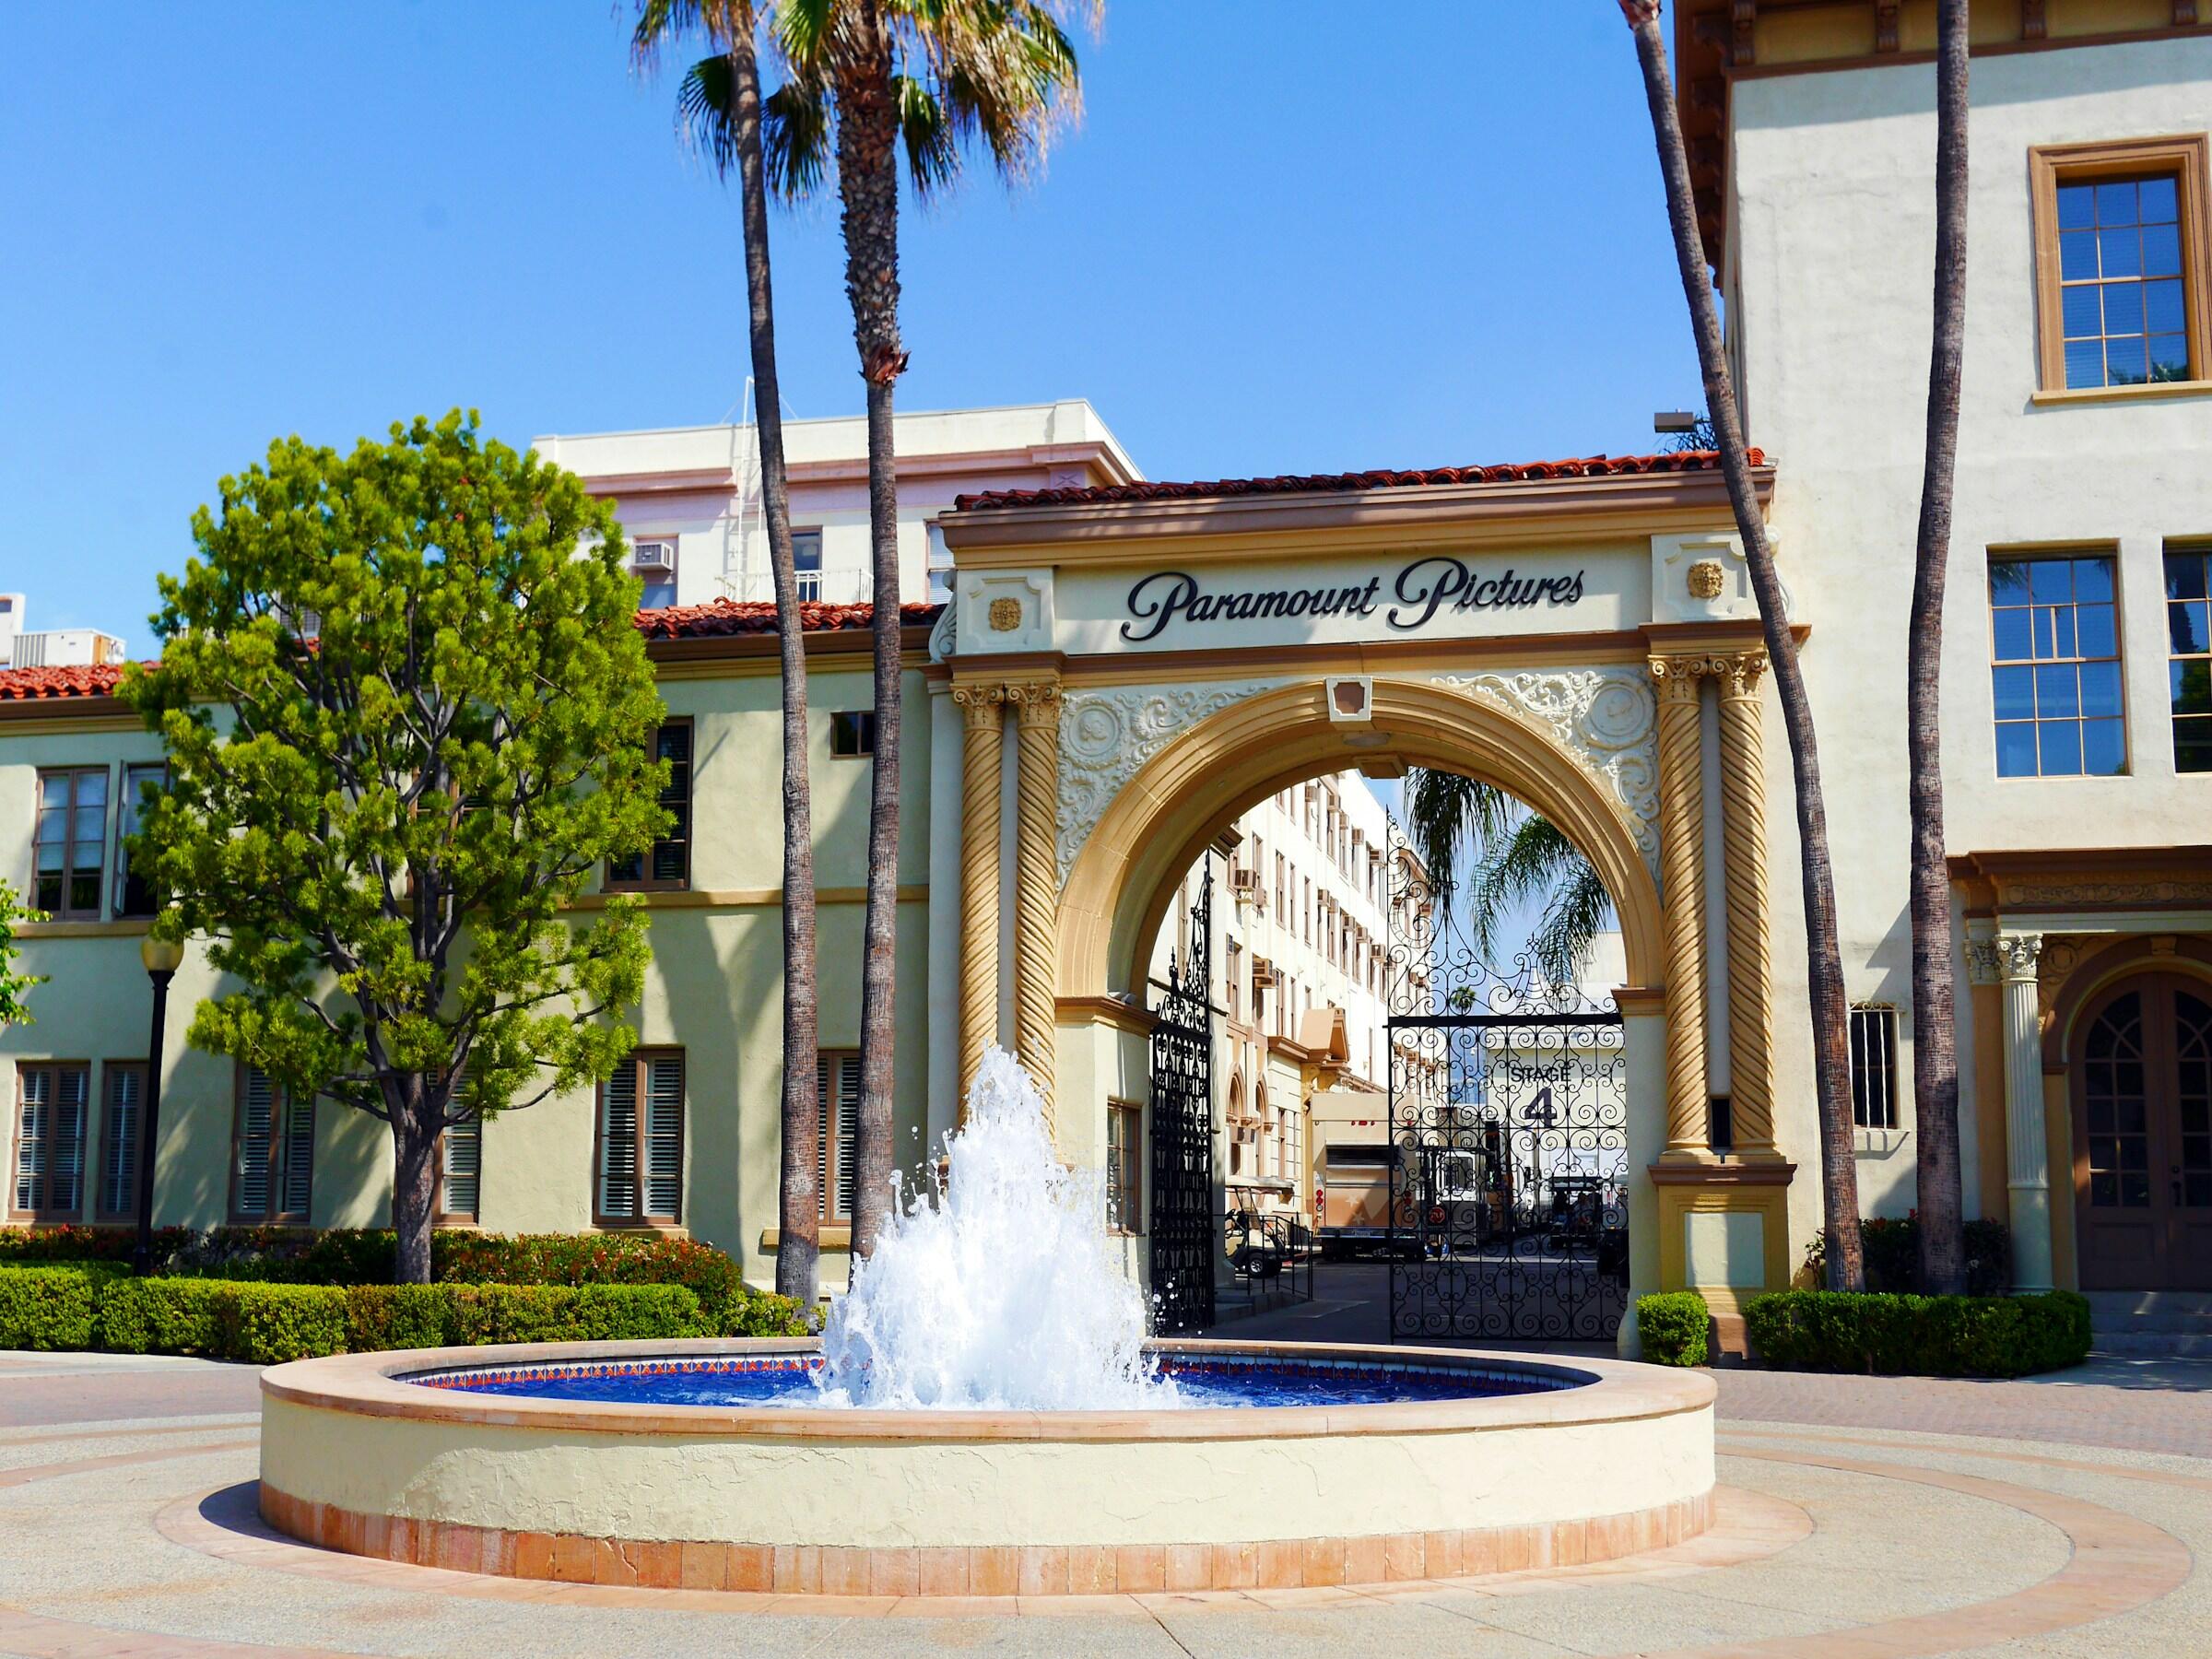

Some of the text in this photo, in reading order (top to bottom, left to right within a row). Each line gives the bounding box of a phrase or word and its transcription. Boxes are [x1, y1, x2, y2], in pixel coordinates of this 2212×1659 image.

[1120, 557, 1585, 641] Paramount Pictures
[1511, 1067, 1571, 1082] STAGE
[1524, 1088, 1558, 1128] 4
